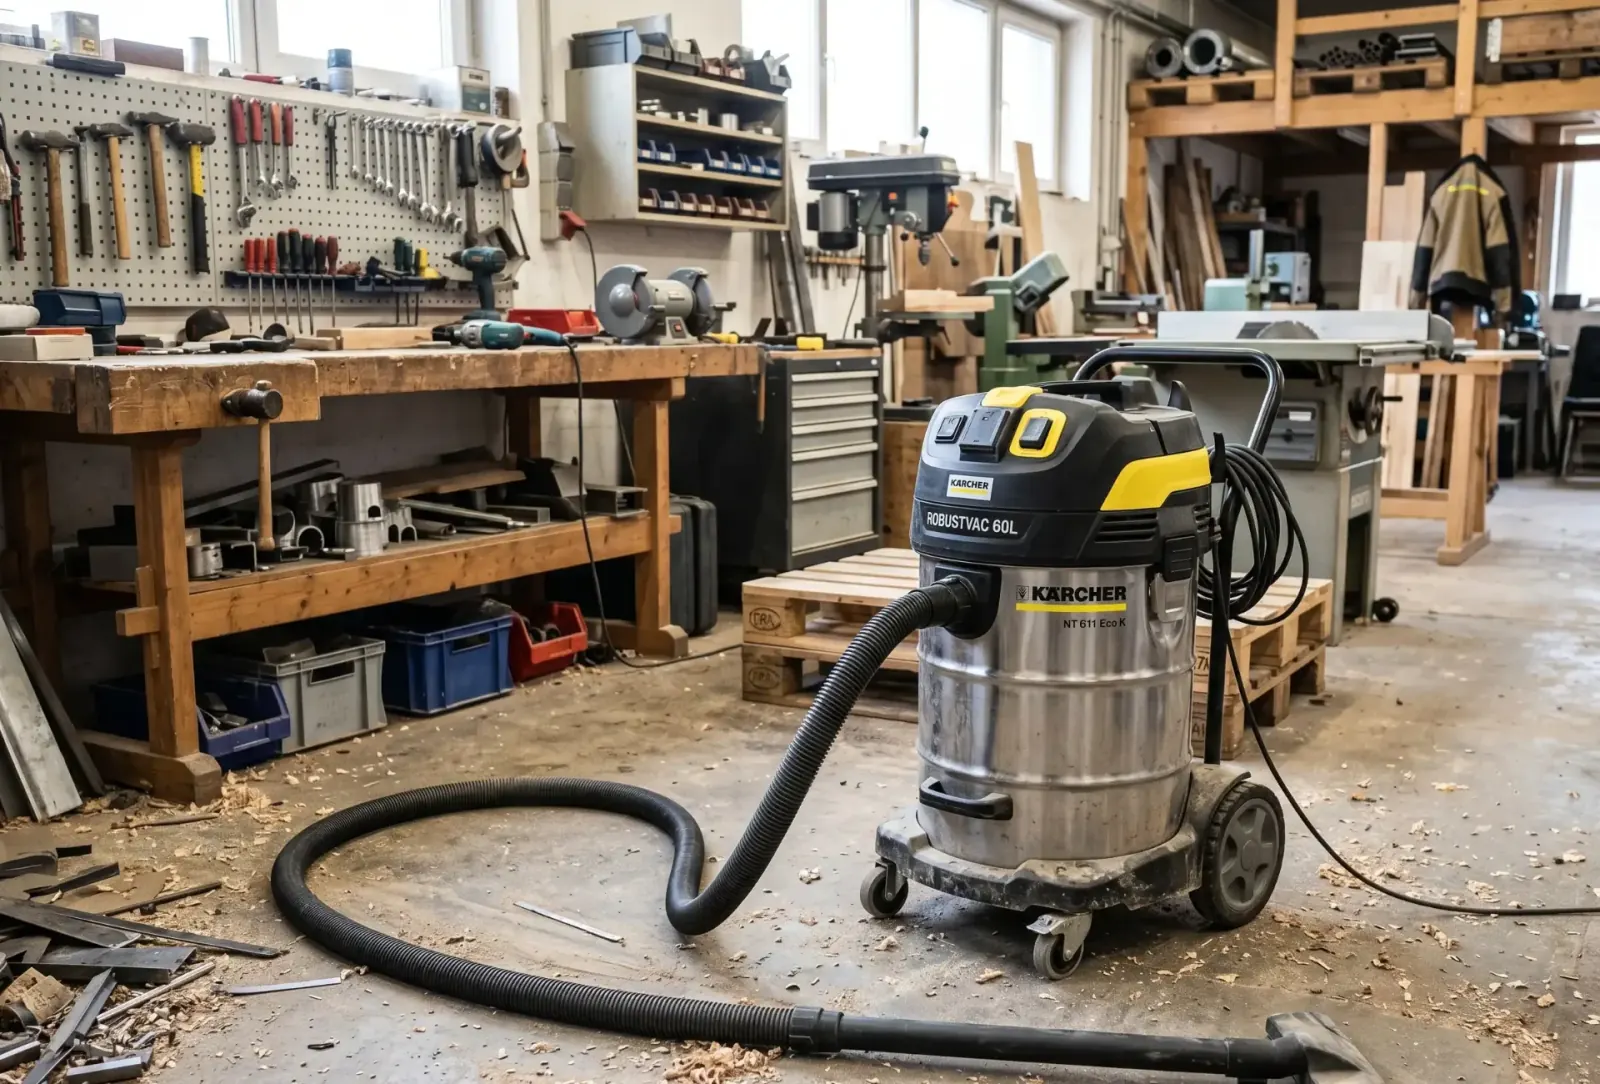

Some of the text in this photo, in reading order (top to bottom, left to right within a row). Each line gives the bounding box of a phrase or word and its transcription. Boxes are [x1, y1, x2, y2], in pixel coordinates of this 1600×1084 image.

[926, 511, 1018, 535] ROBUSTVAC 60L
[1032, 585, 1127, 602] KÄRCHER
[1063, 617, 1126, 629] NT 611 Eco K
